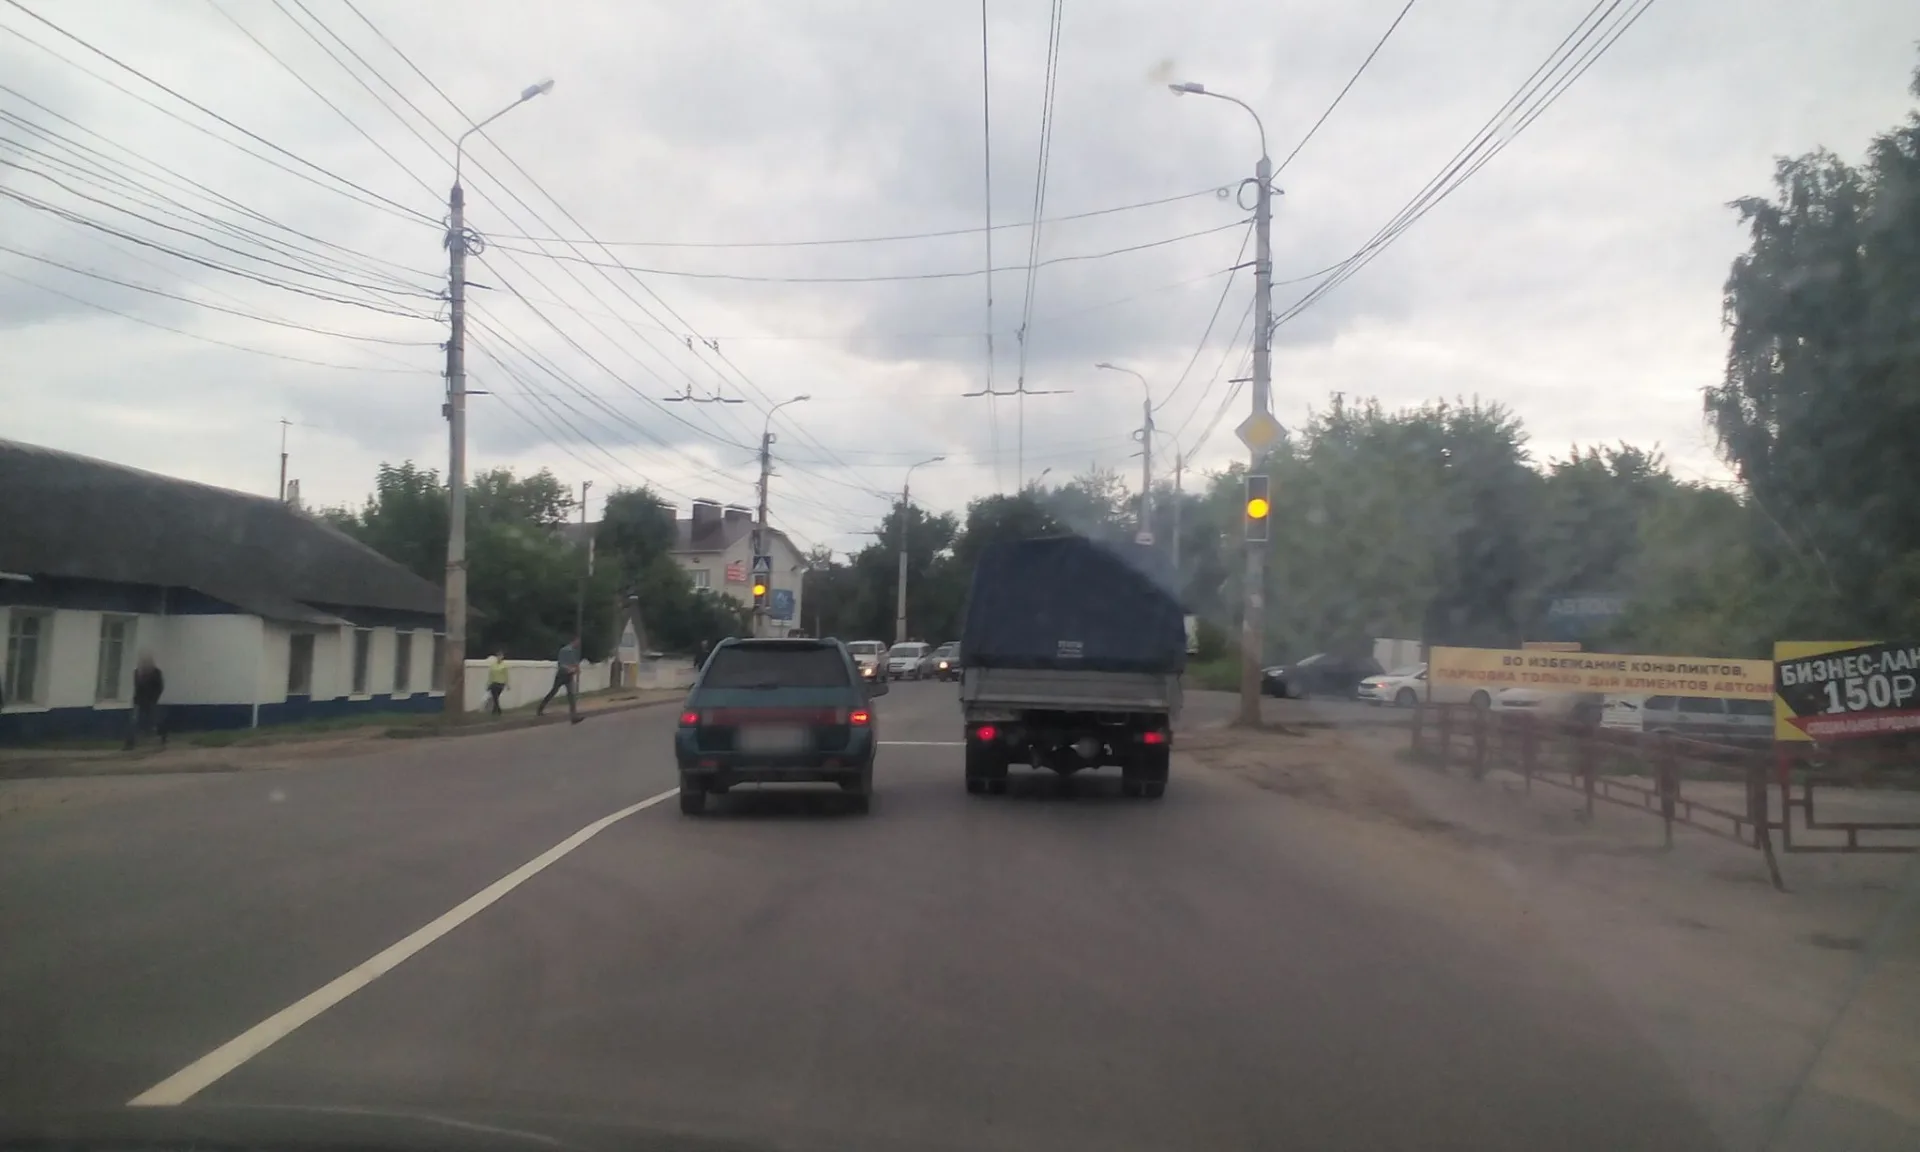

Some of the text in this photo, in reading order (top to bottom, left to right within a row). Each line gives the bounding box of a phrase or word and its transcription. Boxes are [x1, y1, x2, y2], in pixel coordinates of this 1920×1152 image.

[1503, 656, 1747, 677] ВО ИЗБЕЖАНИЕ КОНФЛИКТОВ,
[1437, 668, 1516, 682] ПАРКОВКА
[1521, 672, 1581, 684] ТОЛЬКО
[1625, 678, 1708, 691] КЛИЕНТОВ
